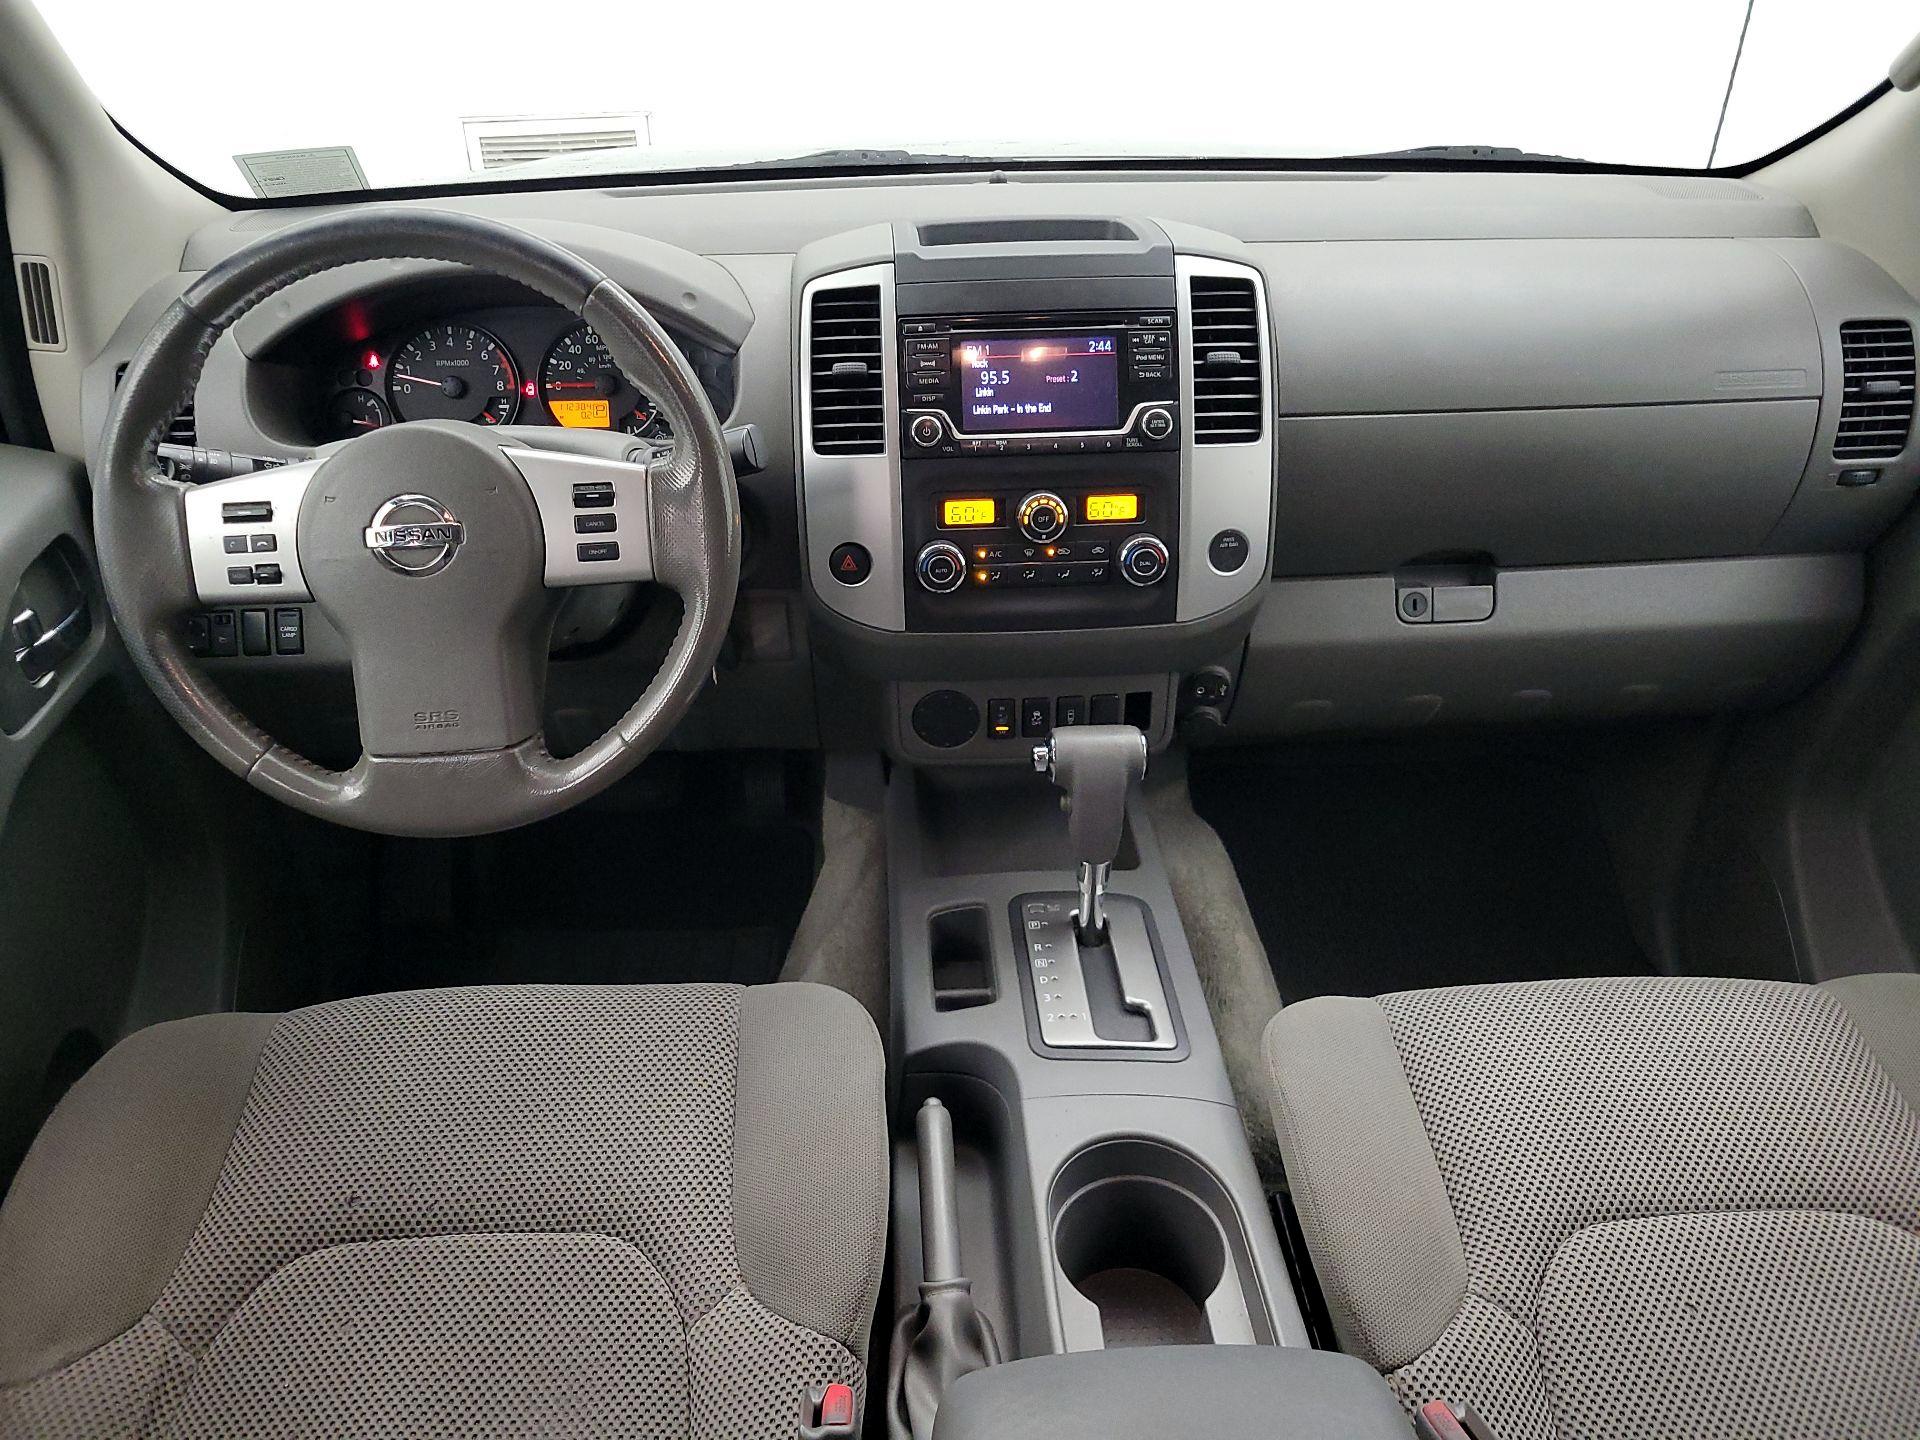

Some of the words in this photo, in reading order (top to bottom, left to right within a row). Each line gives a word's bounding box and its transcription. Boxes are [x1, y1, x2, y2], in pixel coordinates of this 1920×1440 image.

[446, 336, 454, 348] 4
[585, 334, 599, 345] 60
[429, 341, 437, 352] 3
[465, 340, 473, 351] 5
[568, 344, 582, 355] 40
[1088, 340, 1112, 353] 2:44
[414, 350, 422, 361] 2
[481, 350, 489, 361] 6
[435, 359, 470, 367] RPMx1000
[558, 360, 572, 371] 20
[405, 364, 411, 375] 1
[492, 365, 499, 376] 7
[918, 377, 940, 385] MEDIA
[980, 370, 1010, 385] 95.5
[1045, 374, 1066, 383] Preset
[1070, 369, 1078, 383] 2
[403, 383, 412, 394] 0
[496, 380, 504, 391] 8
[992, 403, 1010, 414] Park
[1024, 402, 1038, 414] the
[1038, 401, 1052, 413] End
[1037, 515, 1049, 523] OFF
[374, 527, 452, 543] NISSAN
[988, 550, 1003, 558] A/C
[413, 709, 460, 722] SRS
[1033, 943, 1043, 952] R
[1039, 975, 1048, 984] D
[1047, 1013, 1054, 1022] 2
